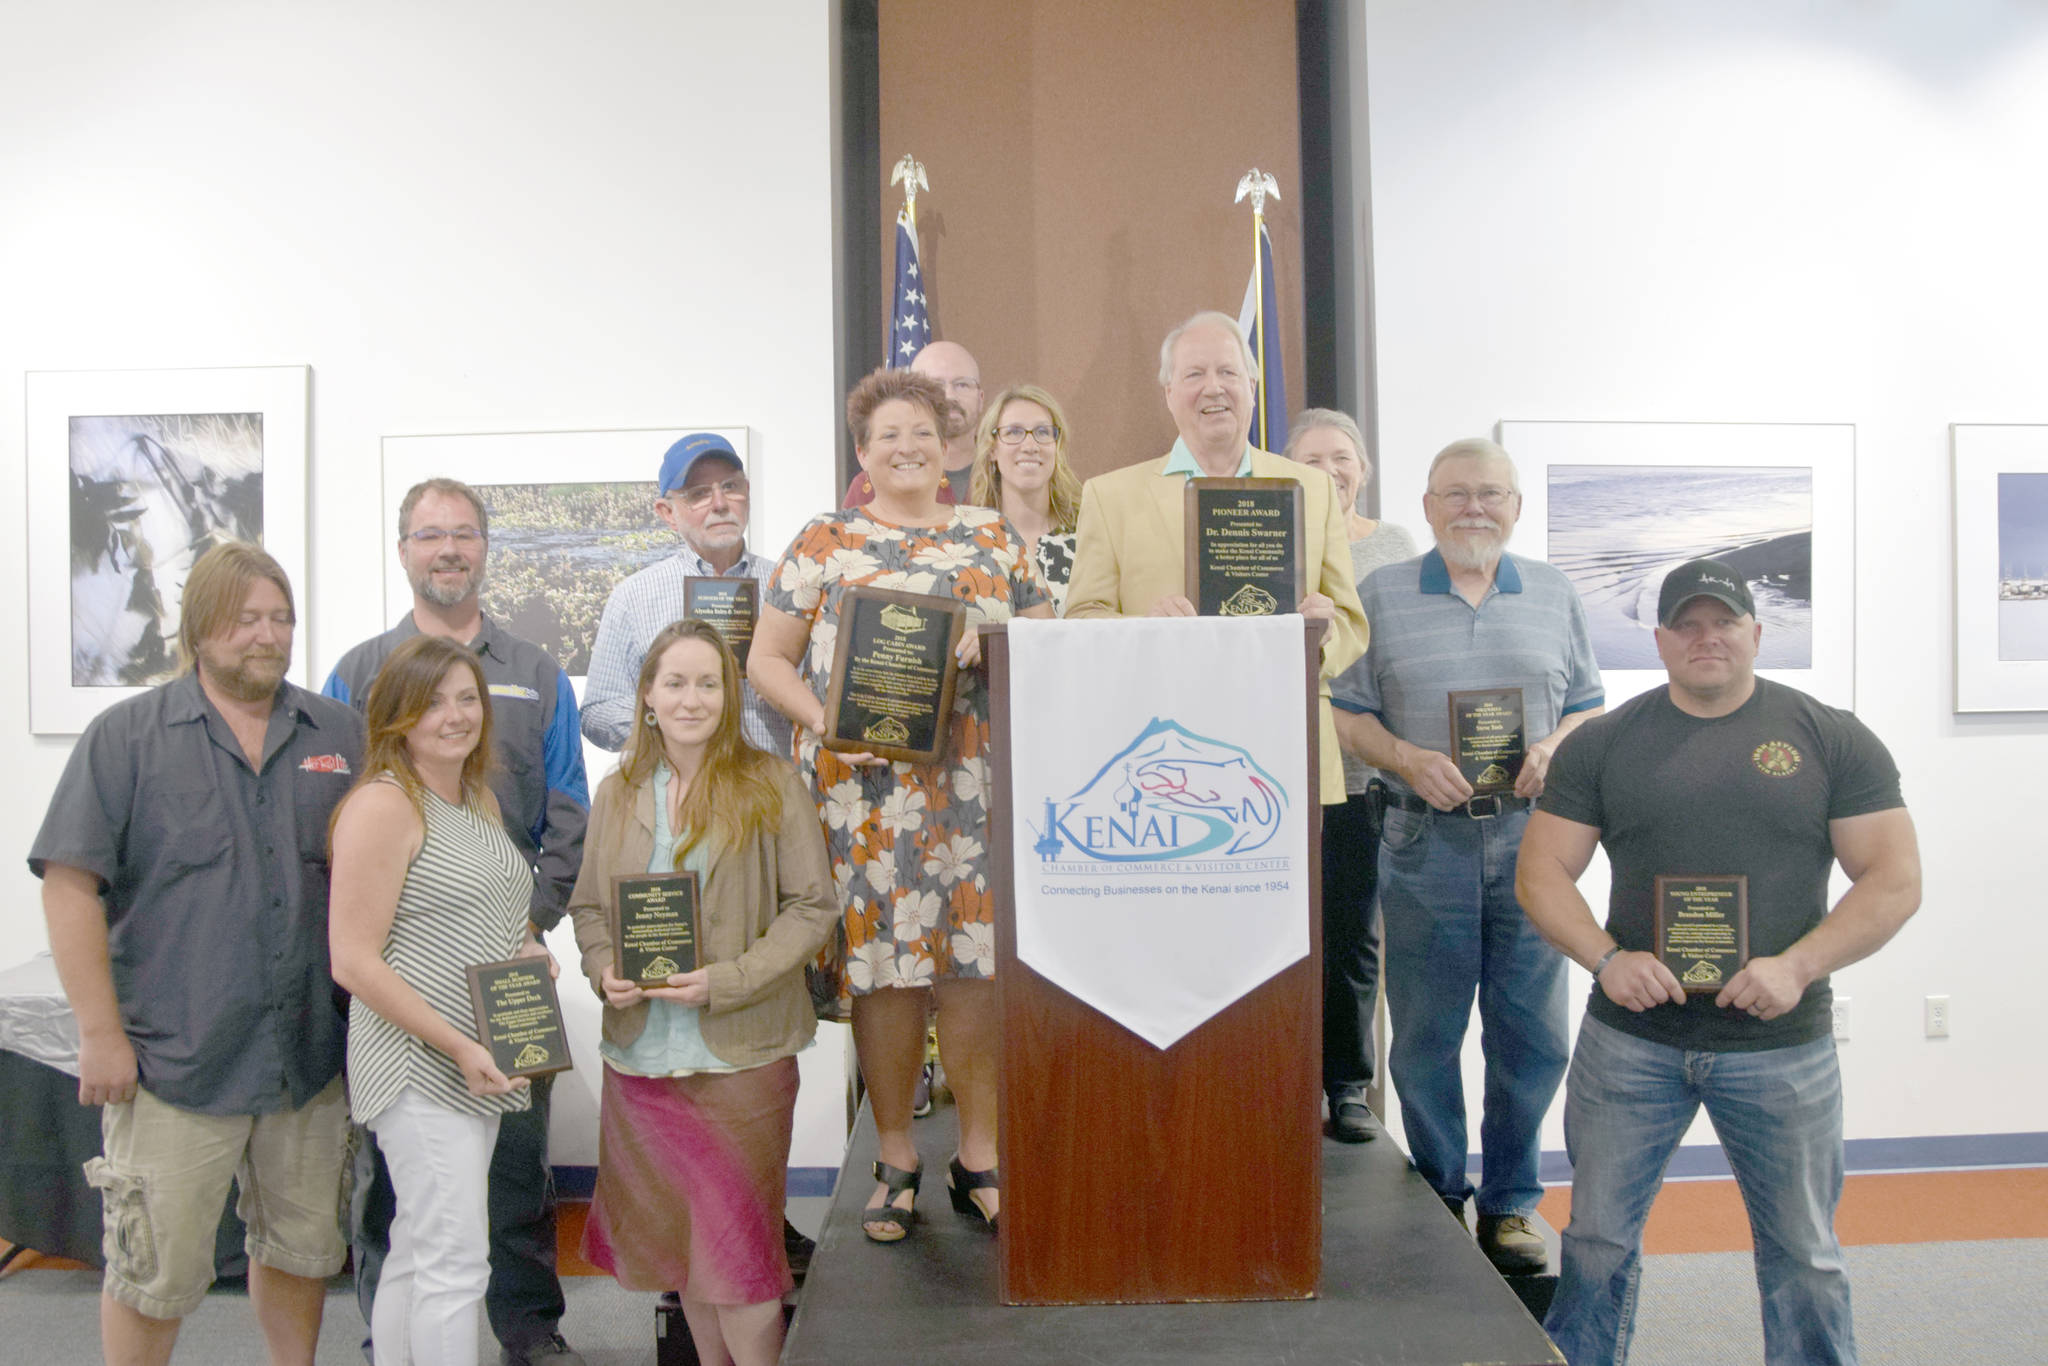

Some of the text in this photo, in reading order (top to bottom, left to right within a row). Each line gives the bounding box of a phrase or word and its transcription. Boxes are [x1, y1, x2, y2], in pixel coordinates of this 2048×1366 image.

[1212, 508, 1281, 517] PIONEER AWARD
[1206, 528, 1287, 537] Dr. Dennis Swarner
[1046, 802, 1181, 851] KENAI
[1041, 860, 1290, 873] CHAMBER OF COMMERCE & VISITOR CENTER
[1041, 881, 1290, 897] Connecting Businesses on the Kenai since 1954
